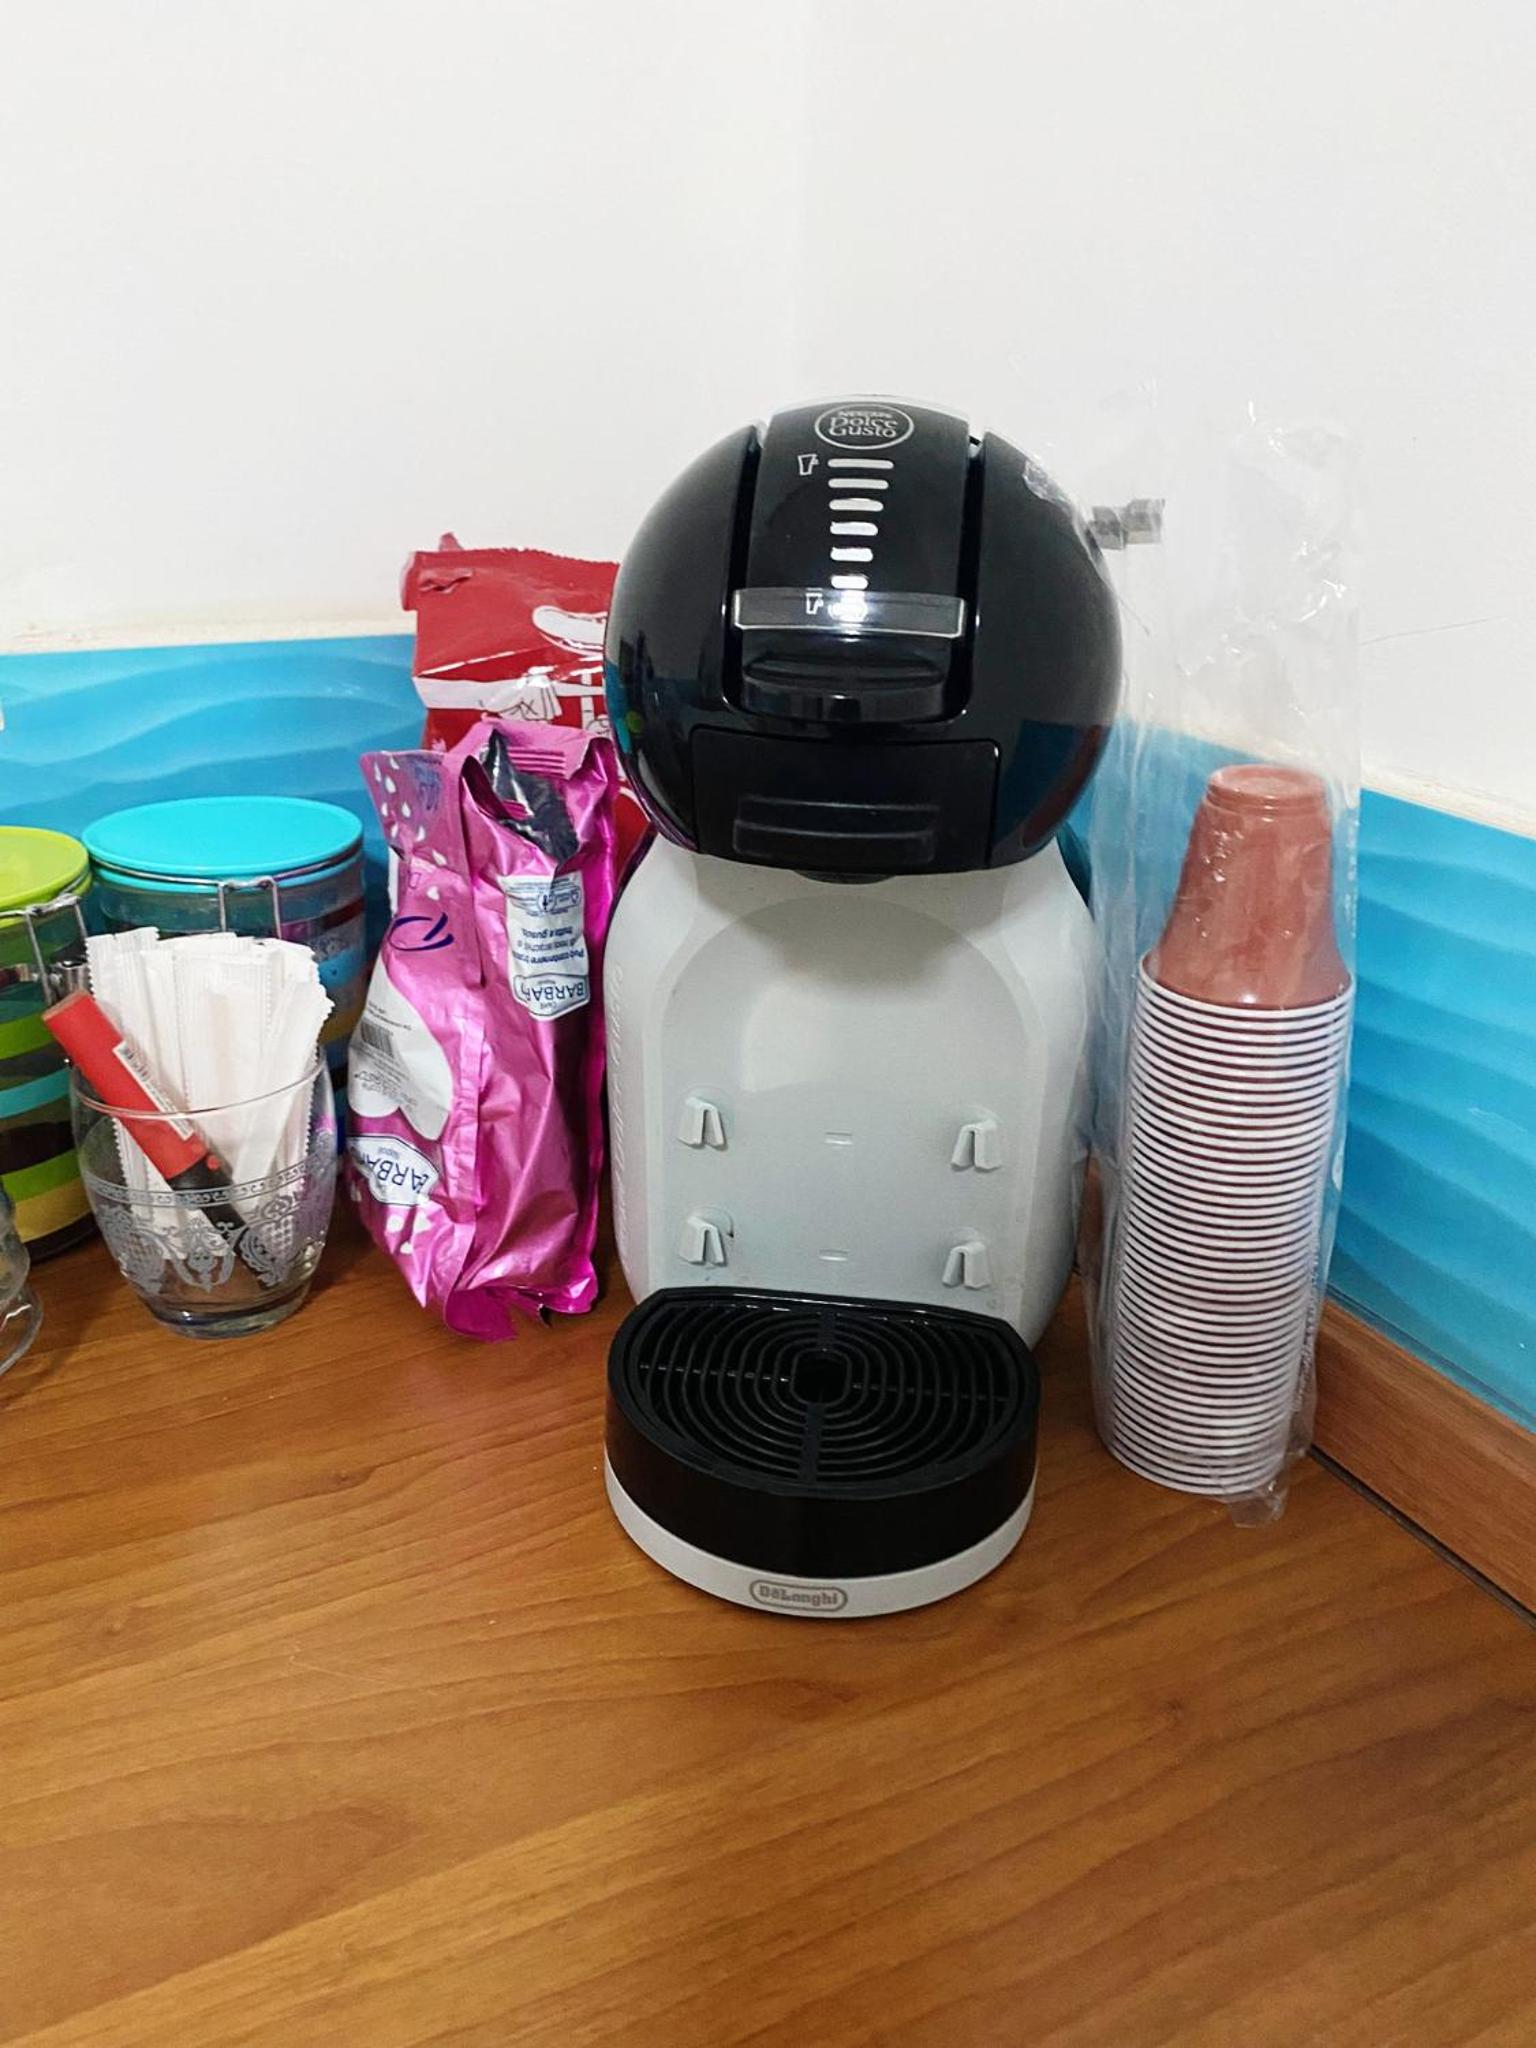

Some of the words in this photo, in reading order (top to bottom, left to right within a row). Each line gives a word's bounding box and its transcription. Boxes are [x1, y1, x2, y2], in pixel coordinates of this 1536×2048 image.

[830, 416, 898, 429] Dolce
[828, 425, 897, 438] Gusto
[361, 1153, 430, 1195] ARBA
